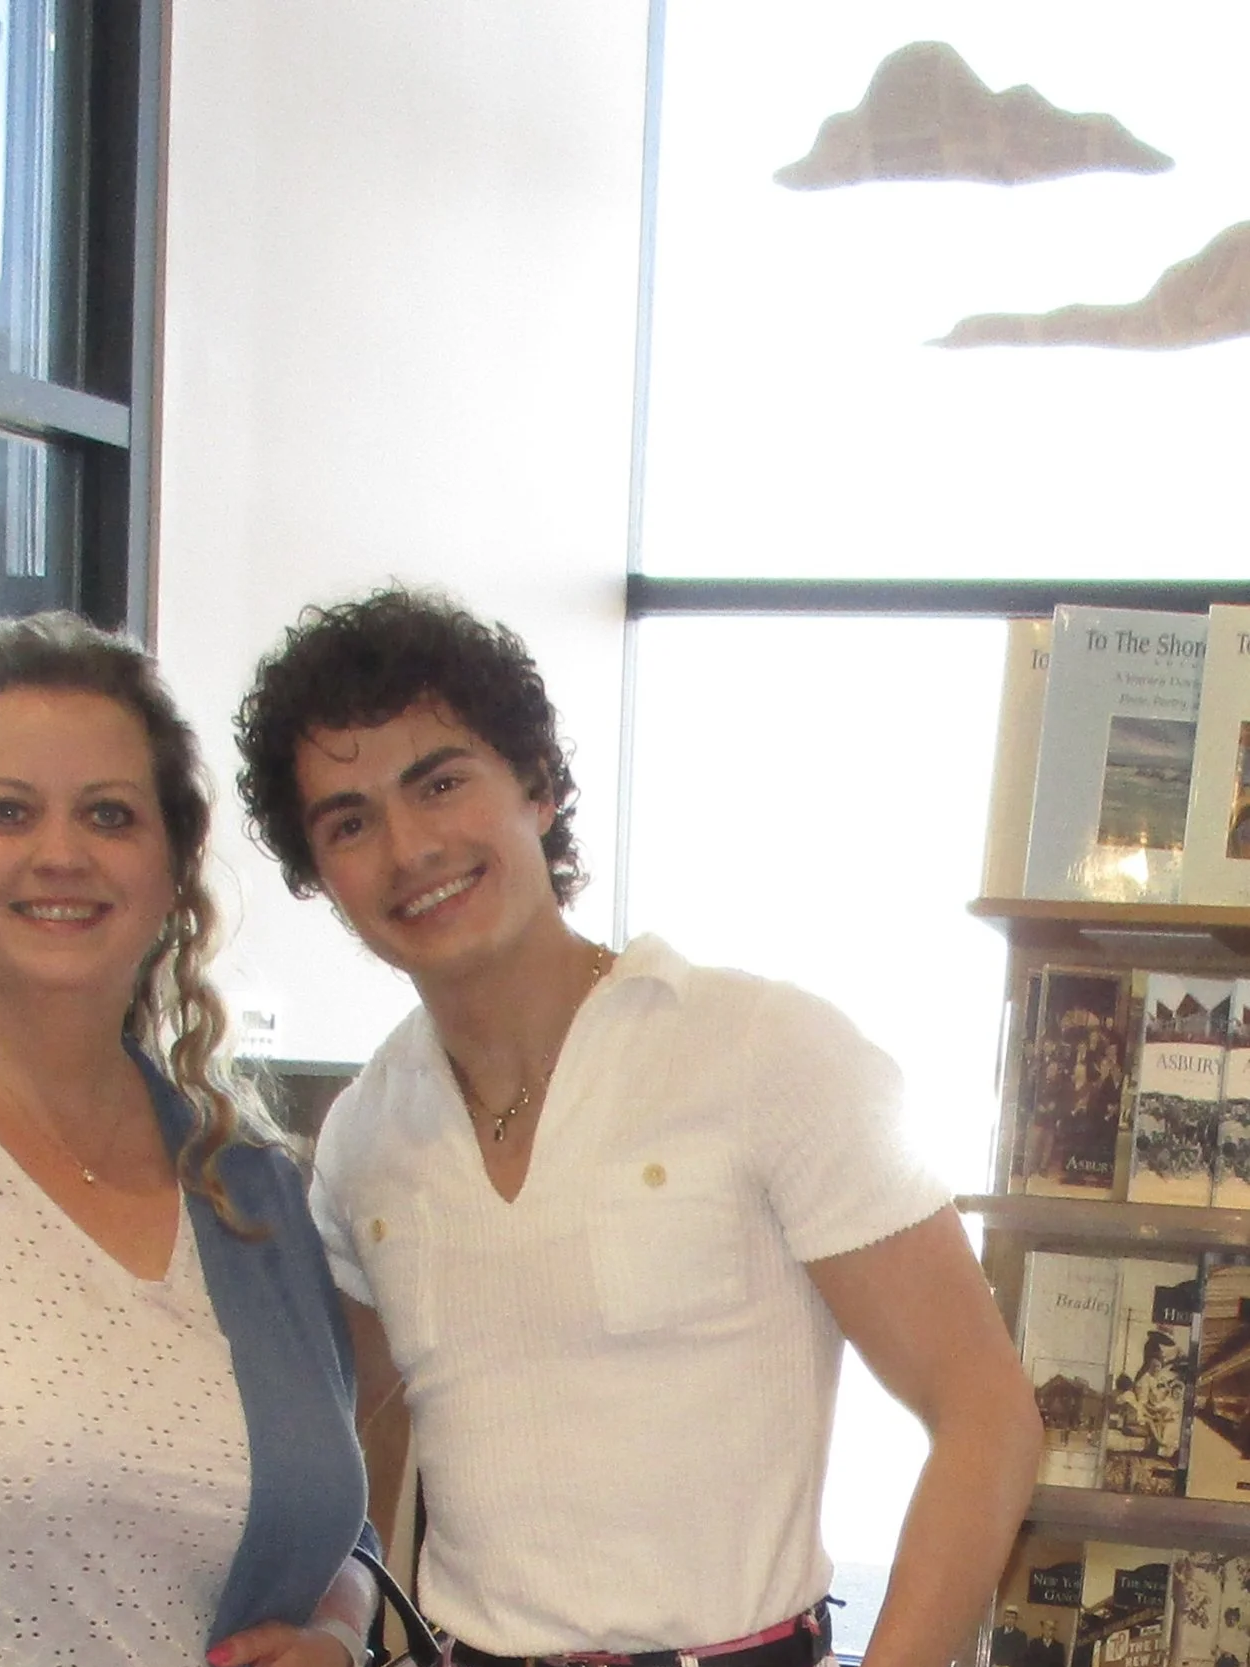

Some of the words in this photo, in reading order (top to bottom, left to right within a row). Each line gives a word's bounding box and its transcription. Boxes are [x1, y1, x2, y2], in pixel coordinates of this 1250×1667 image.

[1086, 629, 1108, 651] To
[1116, 630, 1150, 656] The
[1056, 1293, 1112, 1315] Bradley
